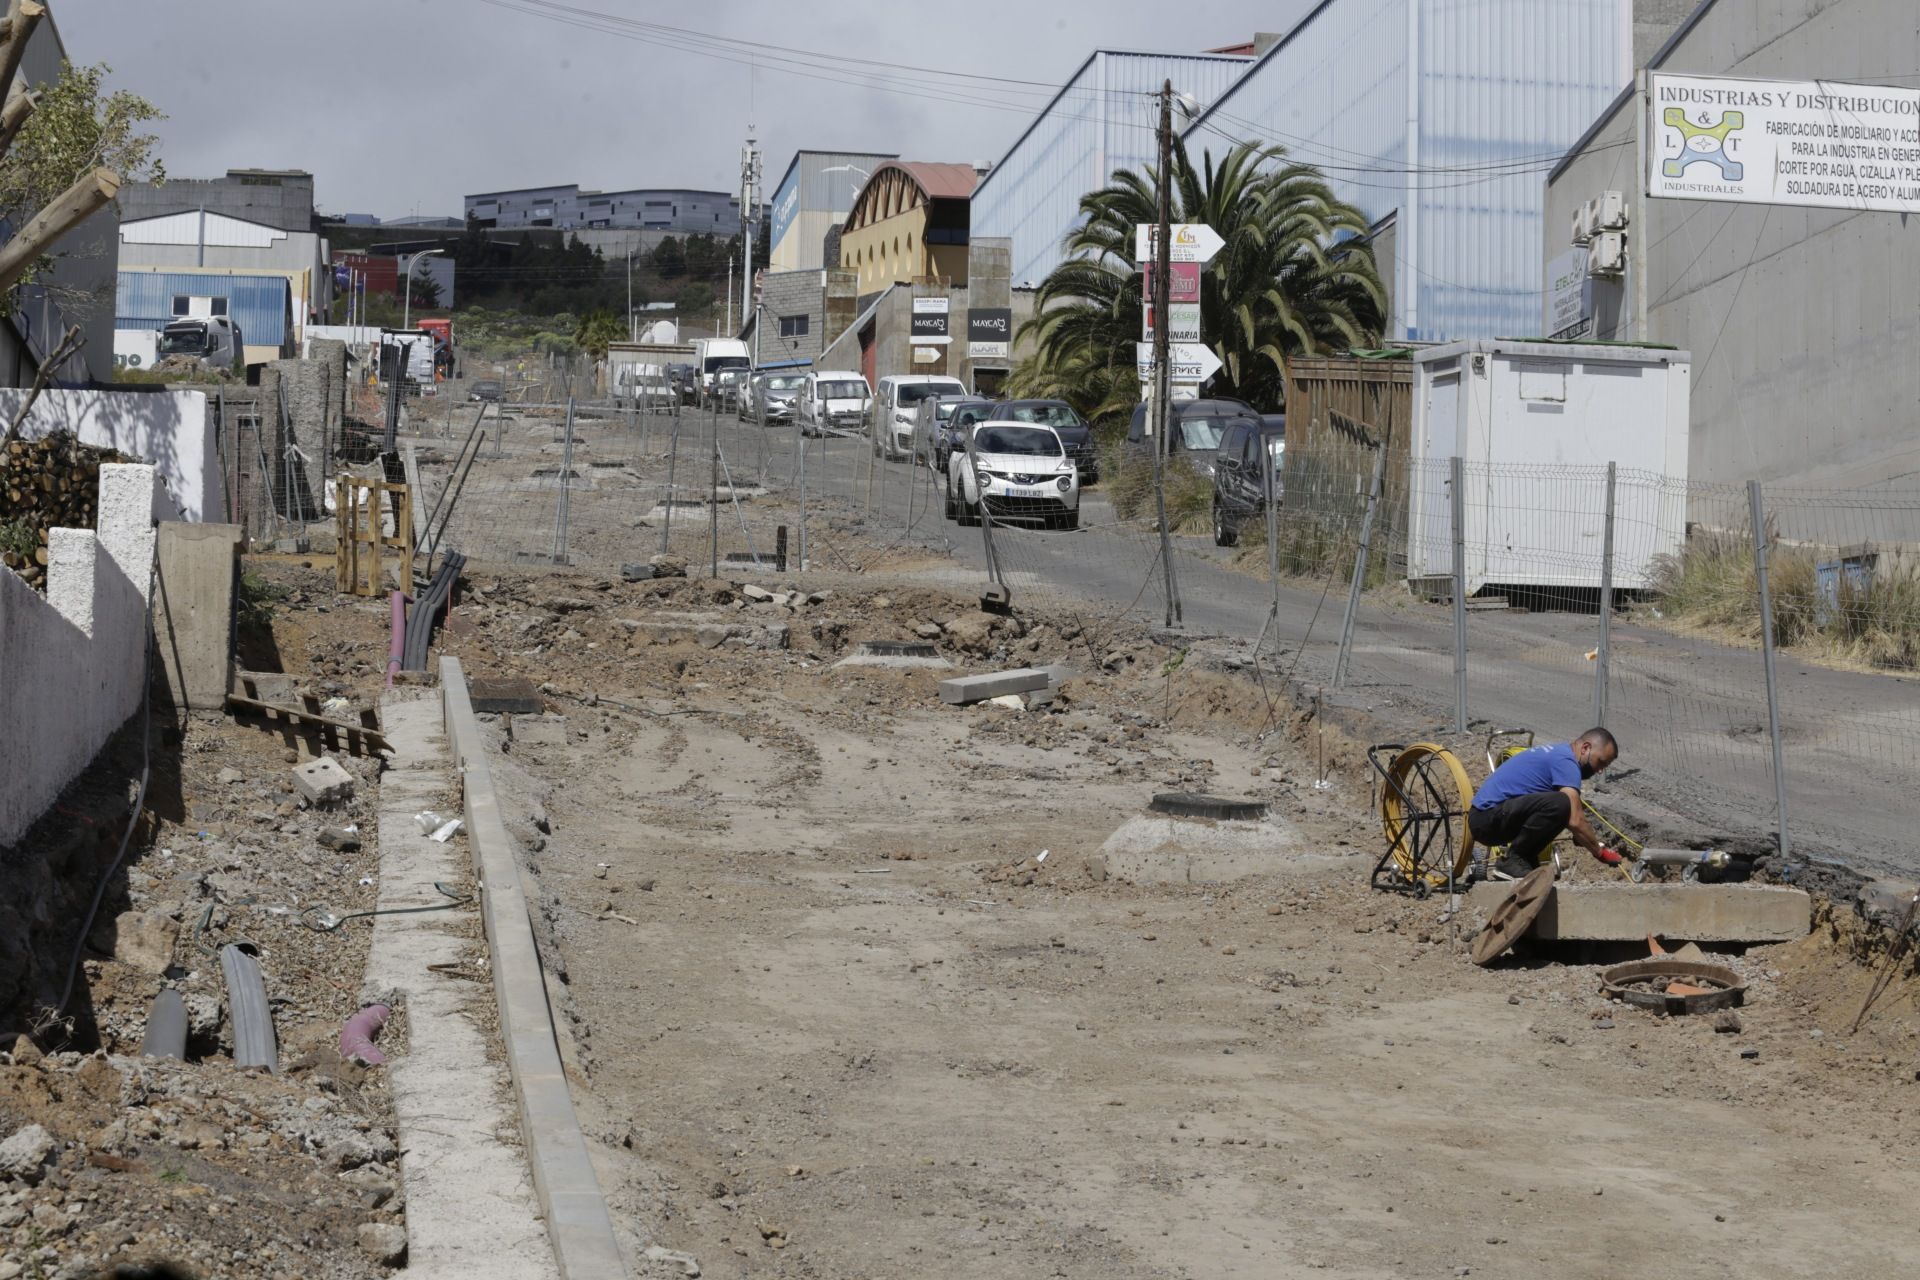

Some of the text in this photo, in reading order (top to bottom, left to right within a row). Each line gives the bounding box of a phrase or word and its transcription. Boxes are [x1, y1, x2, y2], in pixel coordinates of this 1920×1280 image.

[1660, 87, 1772, 107] INDUSTRIAS
[1777, 91, 1791, 107] Y
[1698, 111, 1711, 124] &
[1766, 121, 1919, 143] FABRICACIÓN DE MOBILIARIO Y ACC
[1666, 135, 1742, 151] L T
[1792, 142, 1815, 156] PARA
[1817, 144, 1828, 157] LA
[1830, 144, 1876, 159] INDUSTRIA
[1878, 147, 1889, 160] EN
[1779, 161, 1808, 174] CORTE
[1810, 162, 1828, 176] POR
[1860, 165, 1895, 180] CIZALLA
[1898, 167, 1903, 180] Y
[1664, 182, 1744, 194] INDUSTRIALES
[1787, 180, 1841, 196] SOLDADURA
[1843, 184, 1854, 197] DE
[1857, 185, 1887, 199] ACERO
[1889, 186, 1896, 199] Y
[1171, 366, 1202, 375] ERVICE
